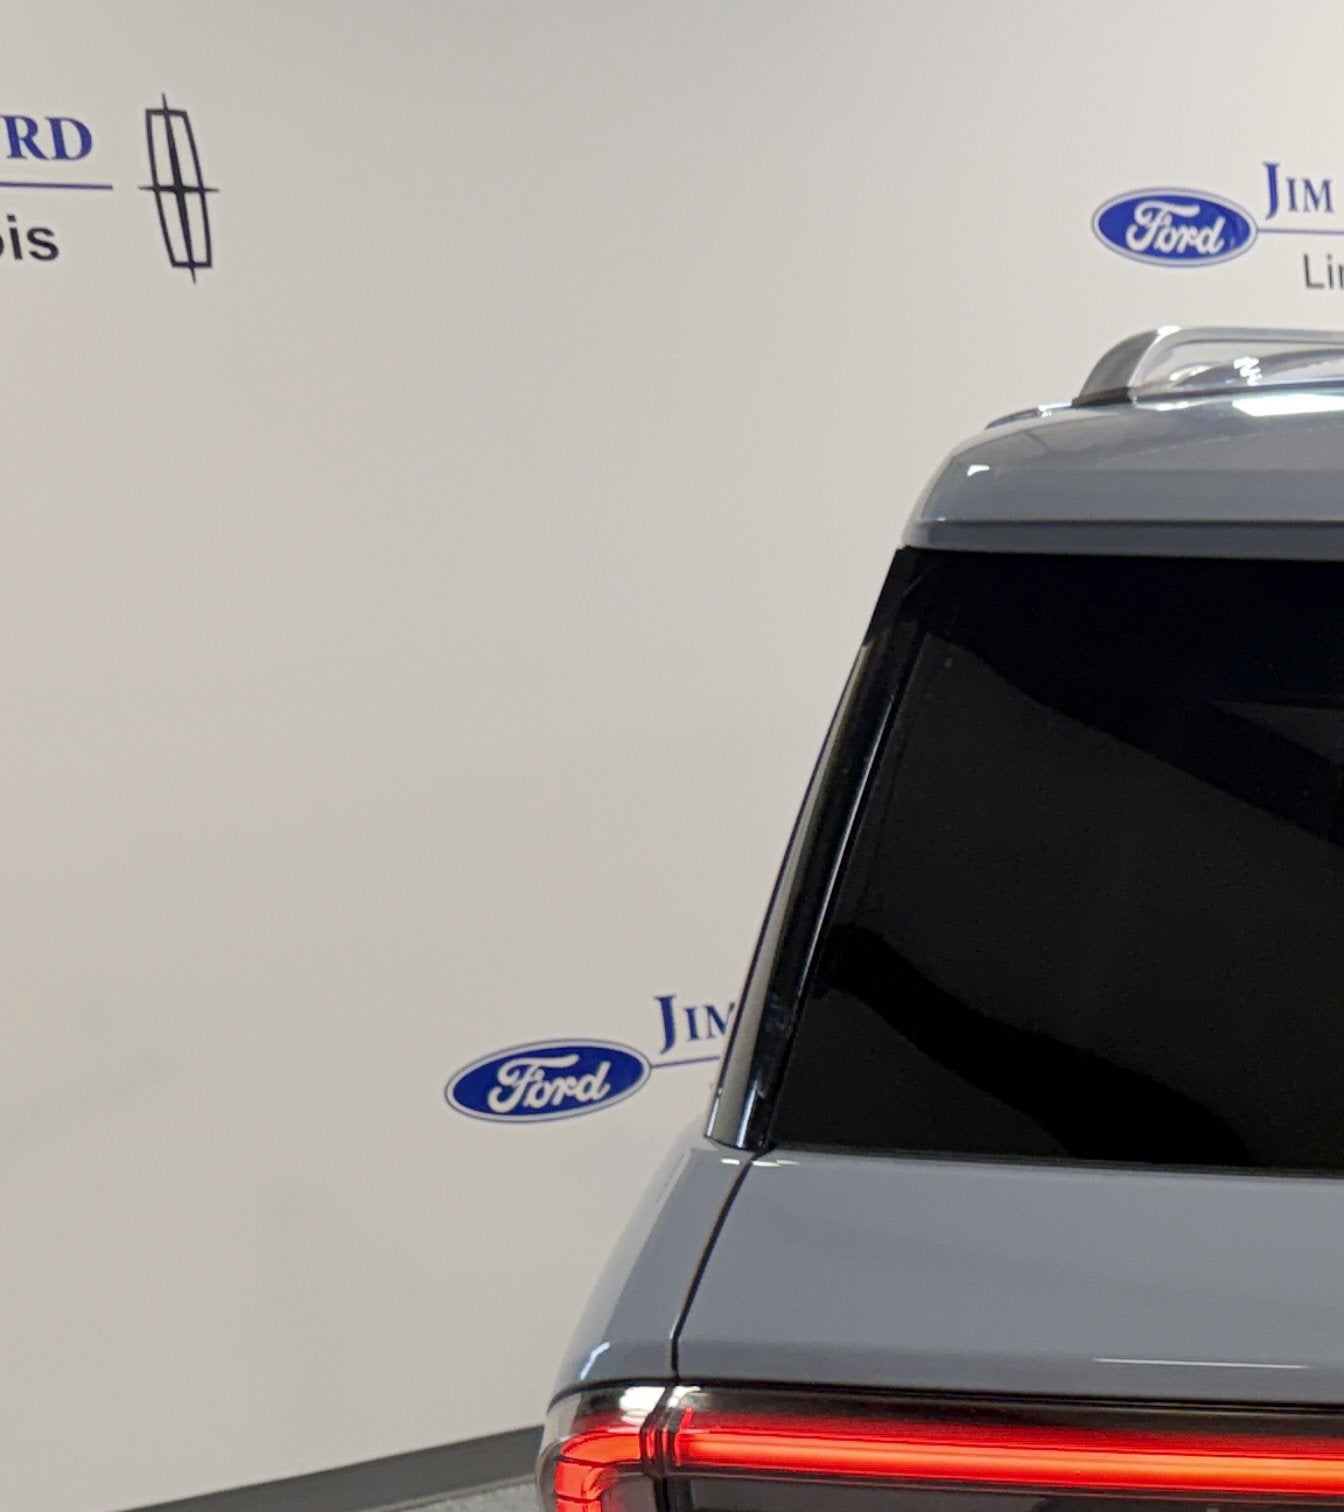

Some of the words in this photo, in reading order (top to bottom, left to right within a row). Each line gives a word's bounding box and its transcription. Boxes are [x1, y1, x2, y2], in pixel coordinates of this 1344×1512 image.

[1262, 161, 1333, 219] JIM
[1126, 199, 1225, 254] Ford
[487, 1053, 611, 1114] Ford
